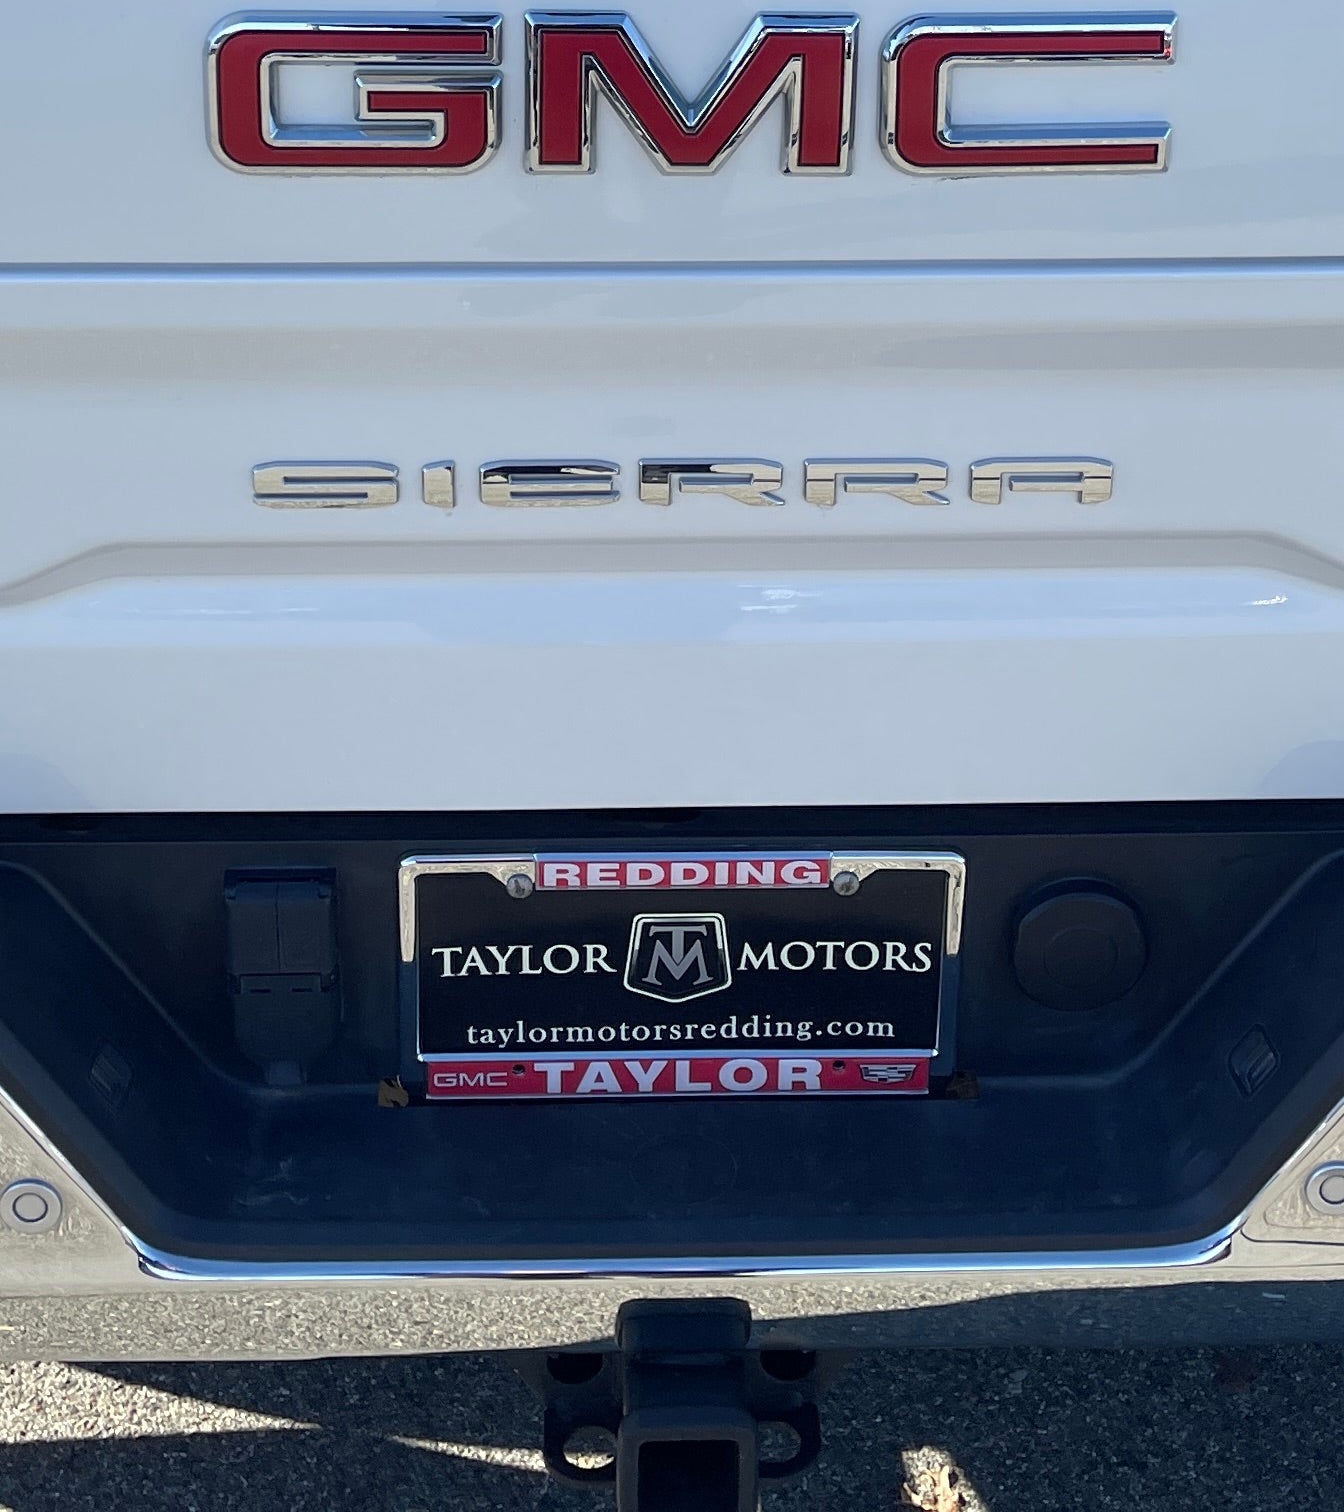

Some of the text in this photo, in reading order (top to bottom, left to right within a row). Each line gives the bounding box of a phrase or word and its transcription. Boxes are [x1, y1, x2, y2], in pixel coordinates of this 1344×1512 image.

[205, 9, 1179, 177] GMC
[252, 457, 1115, 509] SIERRA
[542, 860, 822, 887] REDDING
[431, 944, 618, 978] TAYLOR
[736, 941, 933, 973] MOTORS
[466, 1014, 896, 1049] taylormotorsredding.com
[433, 1058, 823, 1095] GMC TAYLOR
